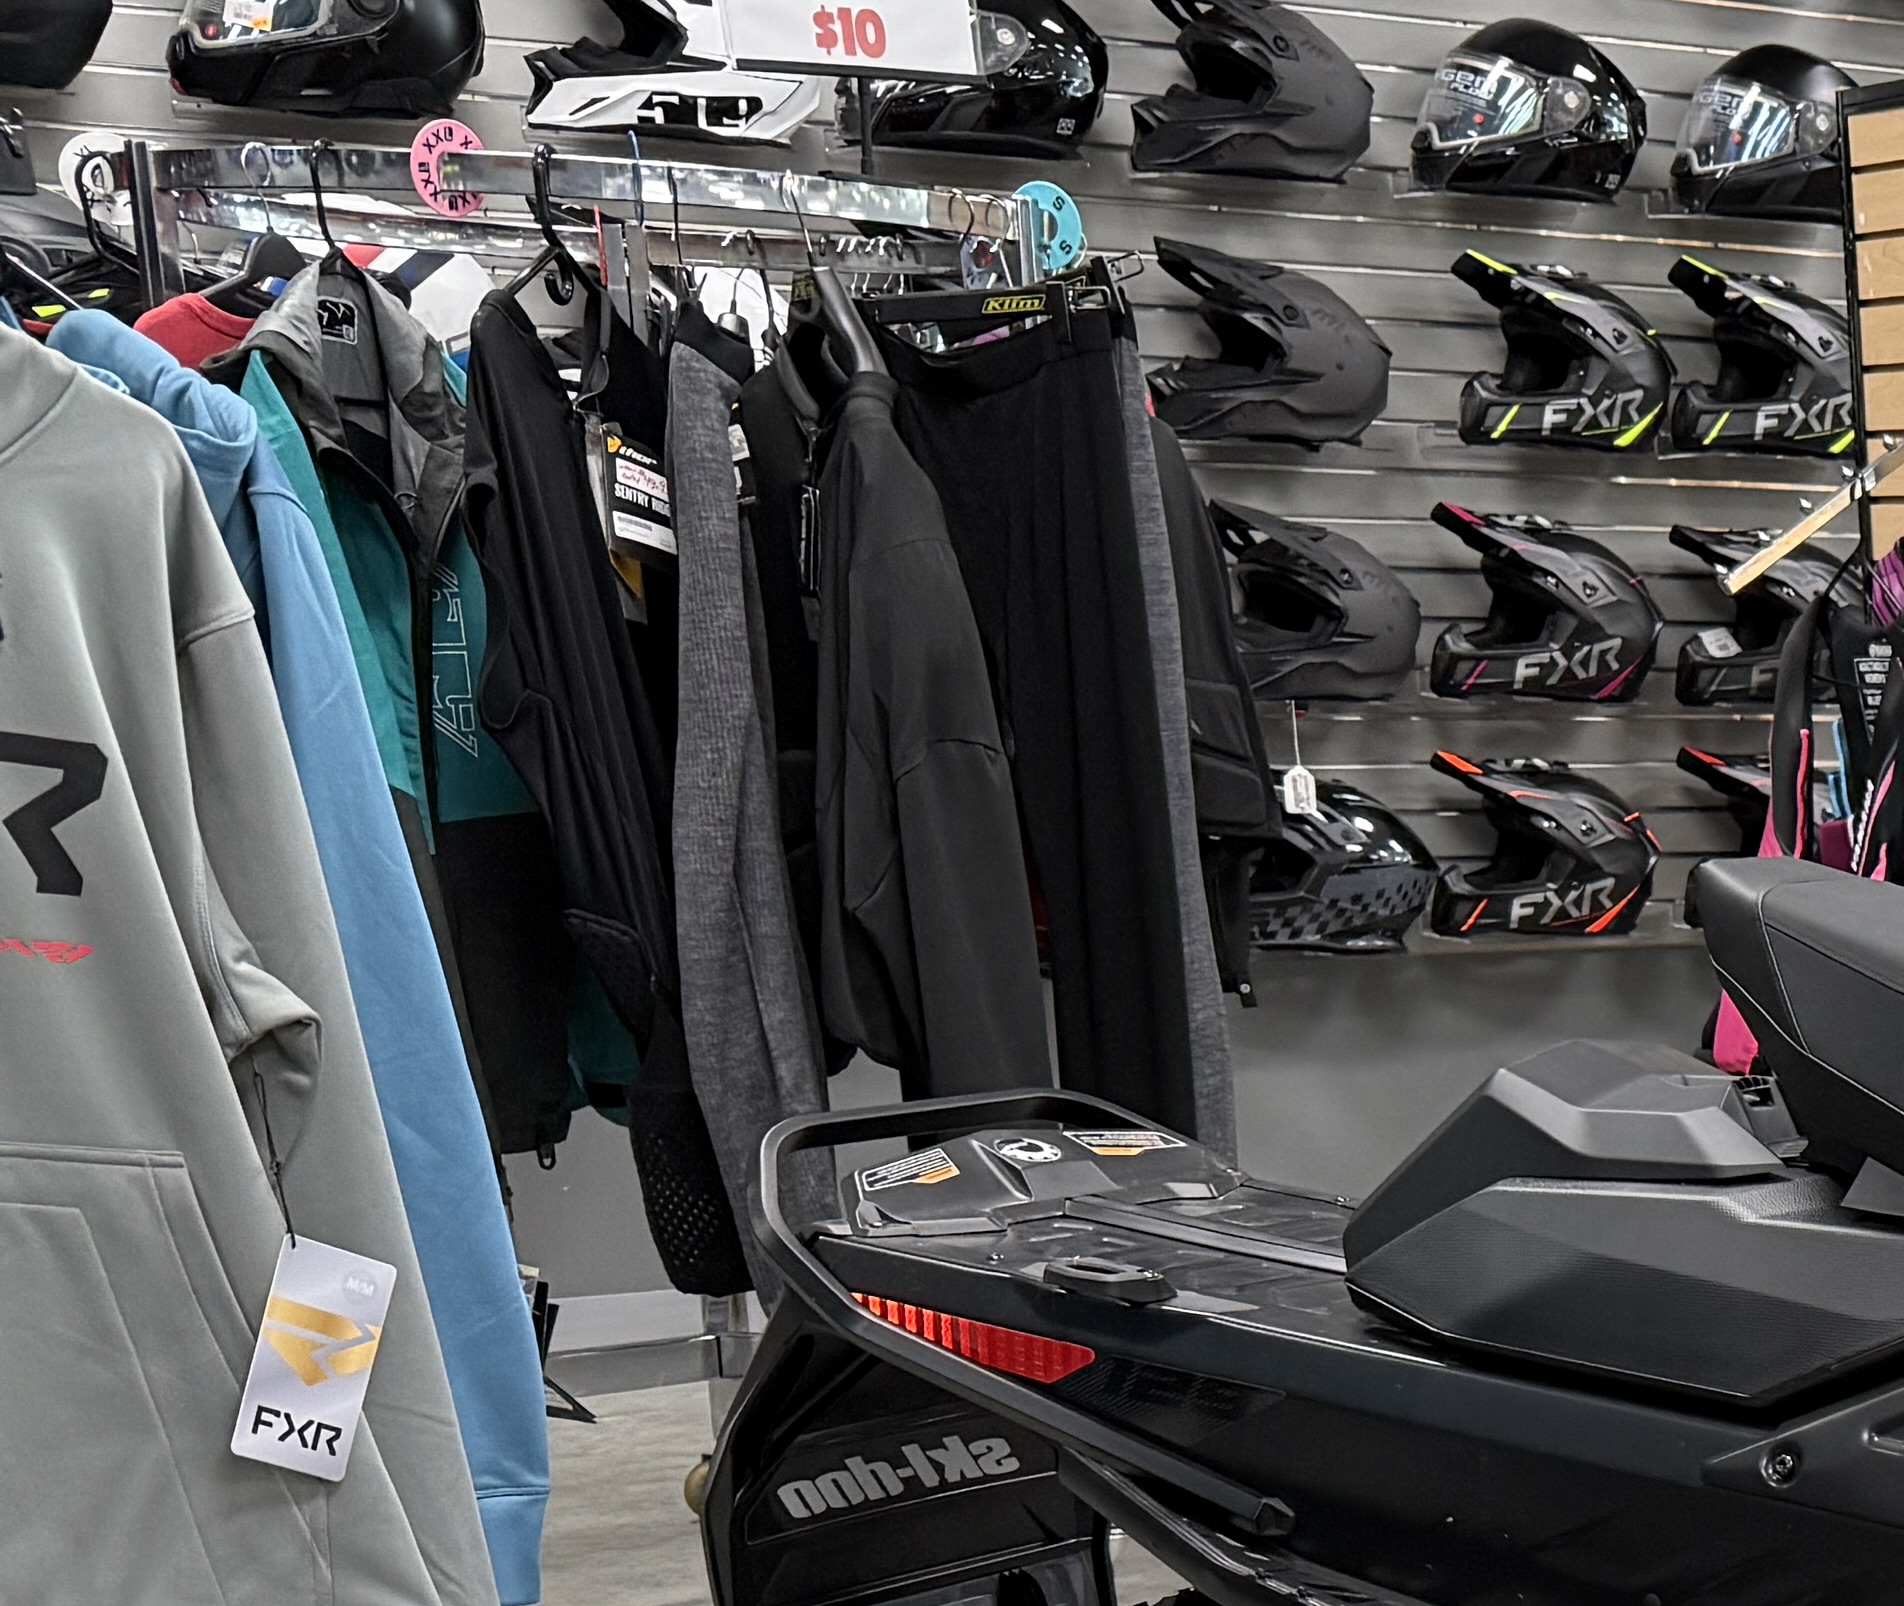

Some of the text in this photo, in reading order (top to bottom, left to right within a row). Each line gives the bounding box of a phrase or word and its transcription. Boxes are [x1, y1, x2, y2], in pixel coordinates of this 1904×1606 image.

[812, 4, 887, 59] $10
[1541, 389, 1644, 436] FXR
[1754, 392, 1853, 440] FXR
[1513, 637, 1622, 689] FXR
[1509, 877, 1615, 929] FXR
[251, 1404, 342, 1457] FXR
